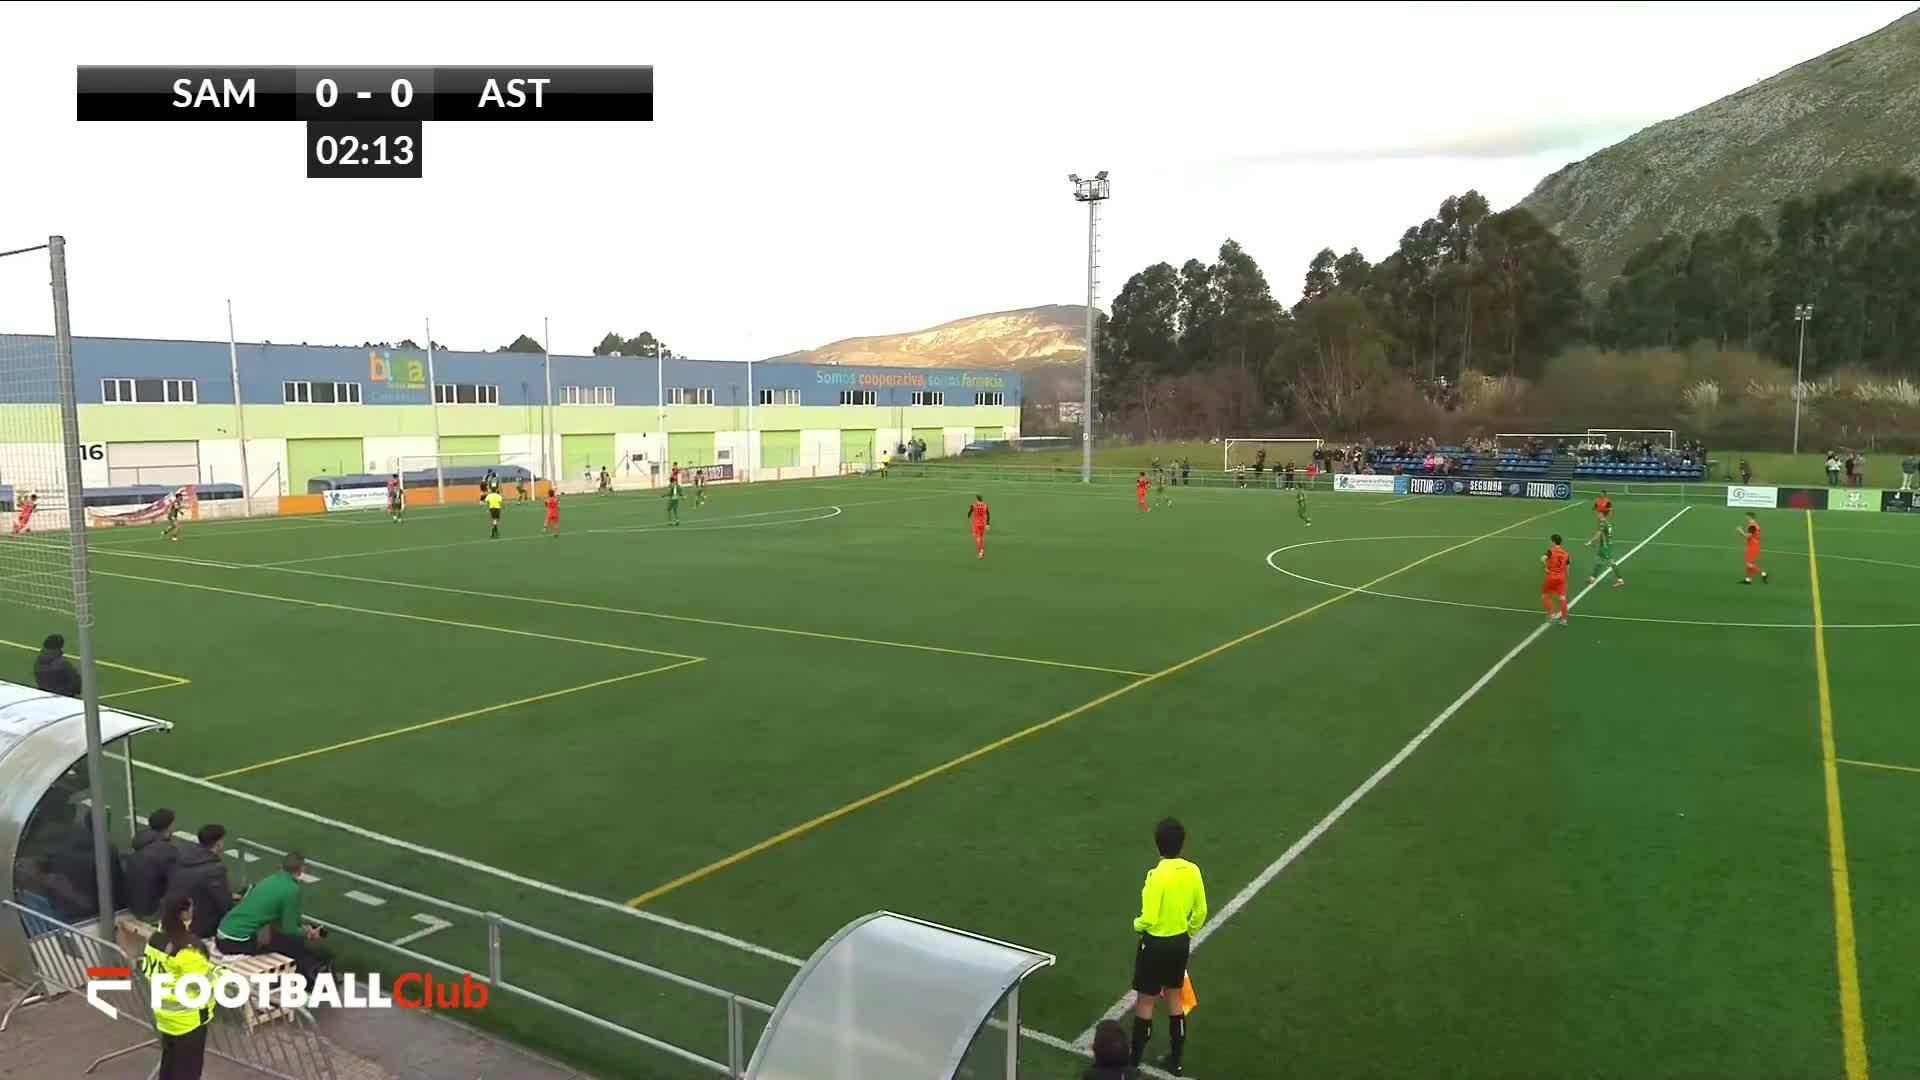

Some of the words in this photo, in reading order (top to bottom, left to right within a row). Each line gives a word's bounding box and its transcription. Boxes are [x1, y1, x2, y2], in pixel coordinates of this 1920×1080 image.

[816, 371, 855, 384] Somos
[80, 444, 104, 460] 16
[1470, 480, 1502, 491] SEGUNDA
